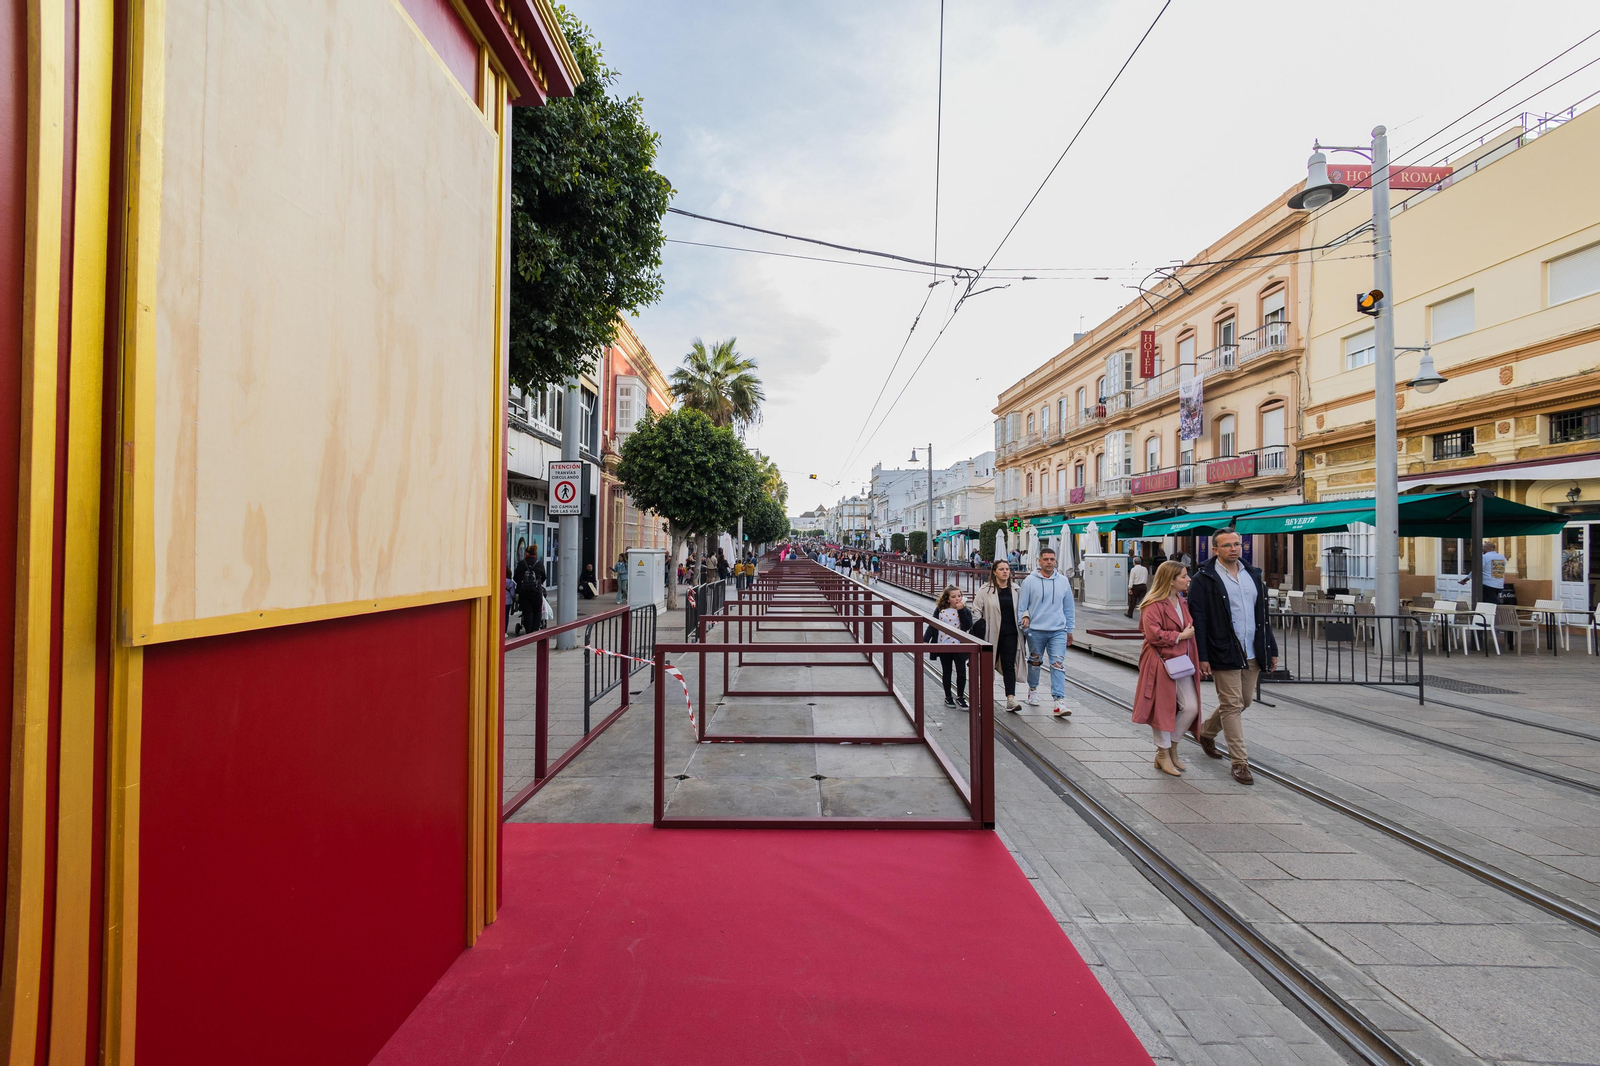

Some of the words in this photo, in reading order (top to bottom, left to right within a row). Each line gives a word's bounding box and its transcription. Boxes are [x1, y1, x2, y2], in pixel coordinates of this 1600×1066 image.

[1401, 172, 1441, 183] ROMA
[1143, 334, 1152, 374] HOTEL
[1144, 474, 1174, 490] HOTEL
[1209, 461, 1246, 480] ROMA
